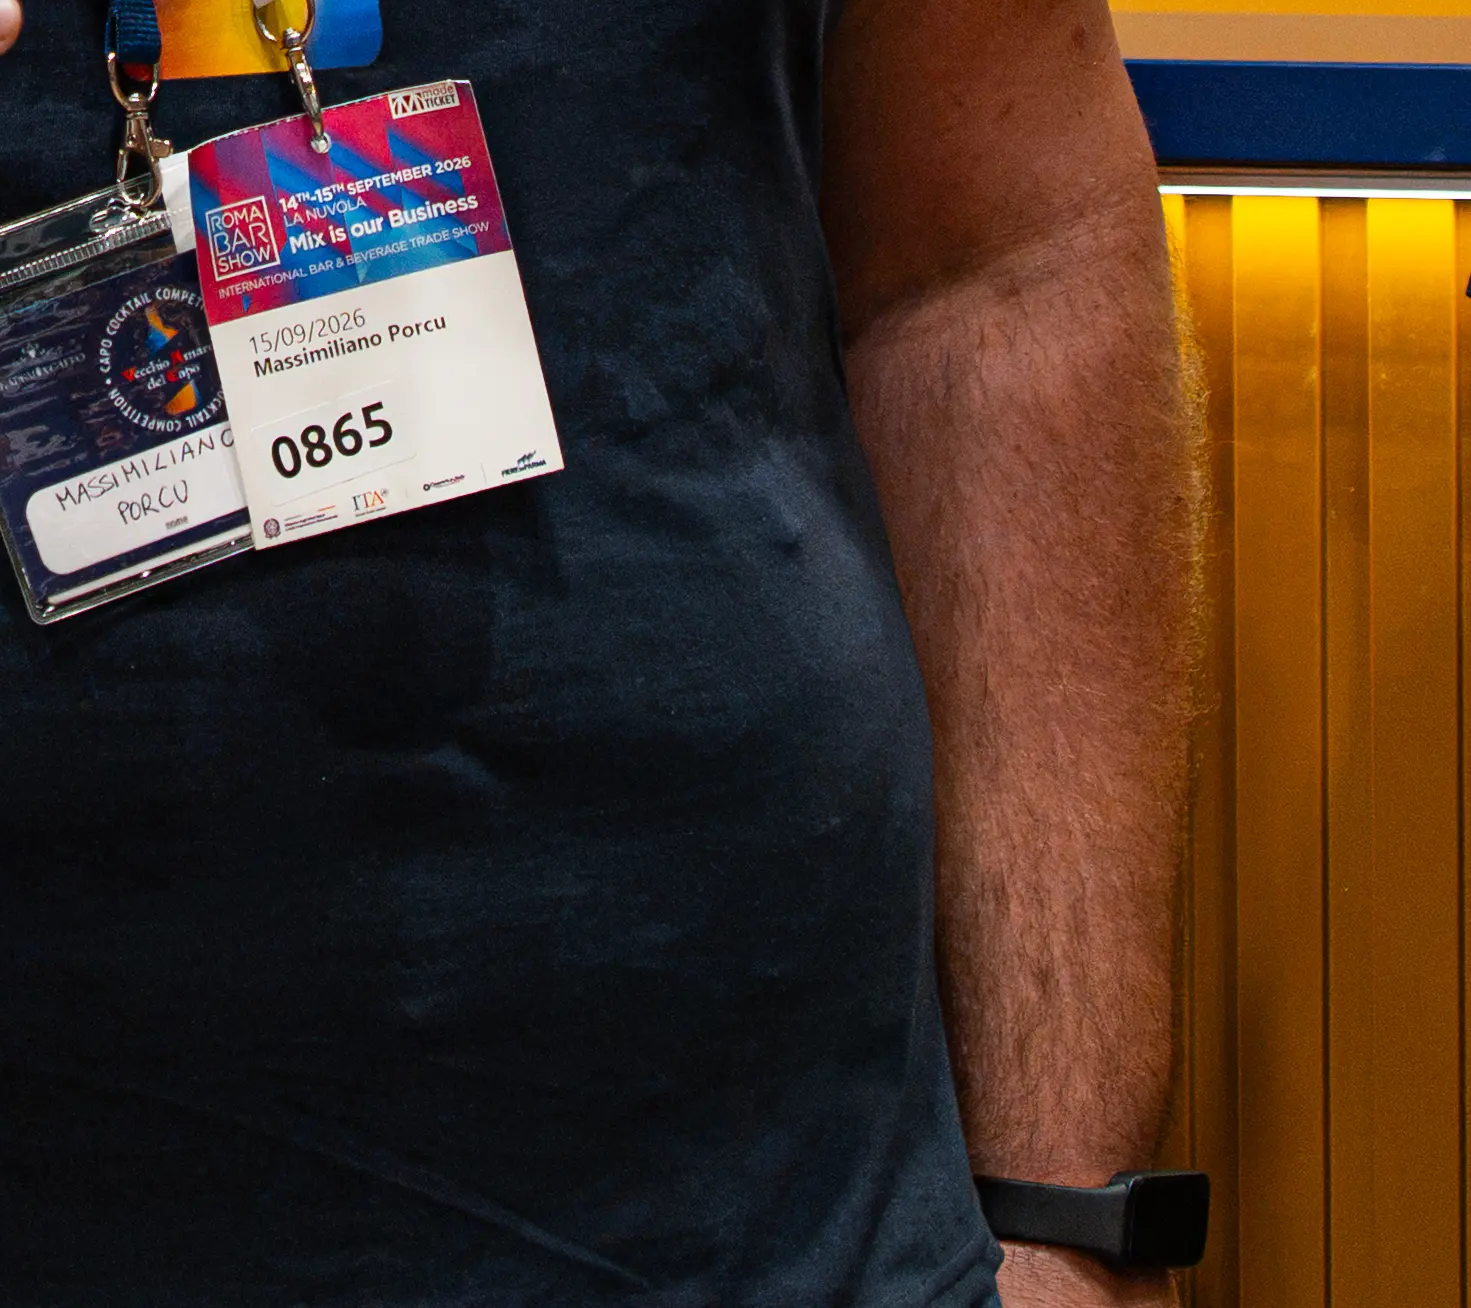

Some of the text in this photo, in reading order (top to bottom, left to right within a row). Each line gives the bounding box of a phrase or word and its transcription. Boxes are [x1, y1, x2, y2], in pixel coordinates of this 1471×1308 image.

[424, 93, 456, 109] TICKET
[279, 156, 472, 213] 14TH-15TH SEPTEMBER 2026
[209, 204, 264, 233] ROMA
[283, 196, 368, 228] LA NUVOLA
[289, 195, 479, 254] Mix is our Business
[213, 222, 268, 257] BAR
[217, 246, 272, 273] SHOW
[218, 220, 490, 300] INTERNATIONAL BAR & BEVERAGE TRADE SHOW
[99, 339, 113, 374] CAPO
[106, 292, 152, 336] COCKTAIL
[155, 287, 204, 310] COMPET
[249, 308, 366, 355] 15/09/2026
[253, 316, 447, 378] Massimiliano Porcu
[147, 372, 167, 391] del
[108, 387, 182, 433] COMPETITION
[271, 401, 394, 479] 0865
[117, 479, 189, 526] PORCU
